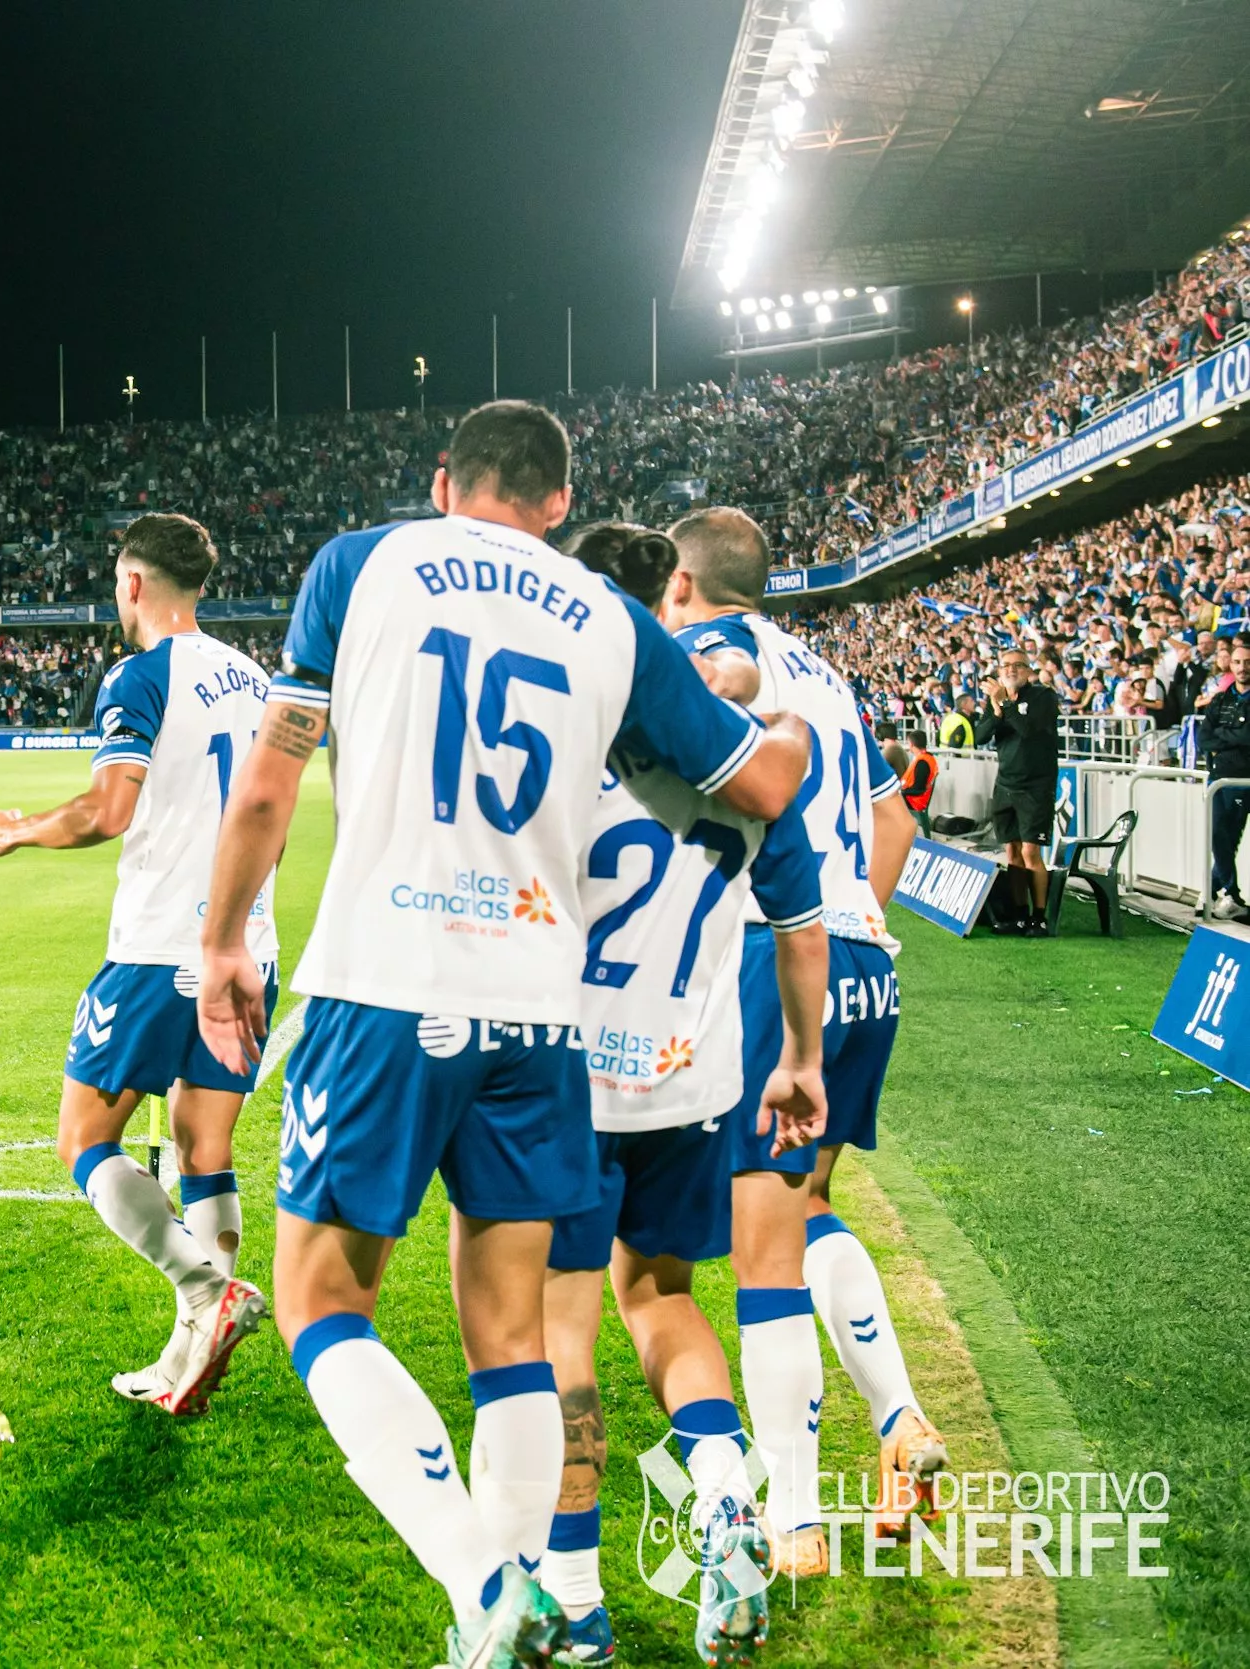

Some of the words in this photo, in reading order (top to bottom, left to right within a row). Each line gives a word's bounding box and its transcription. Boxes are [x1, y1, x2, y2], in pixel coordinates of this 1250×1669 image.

[414, 557, 591, 633] BODIGER
[25, 736, 79, 748] BURGER
[418, 626, 571, 836] 15
[391, 884, 510, 920] Canarias
[454, 867, 510, 896] Islas
[582, 818, 747, 998] 27
[1184, 953, 1240, 1035] jft
[599, 1025, 654, 1055] Islas
